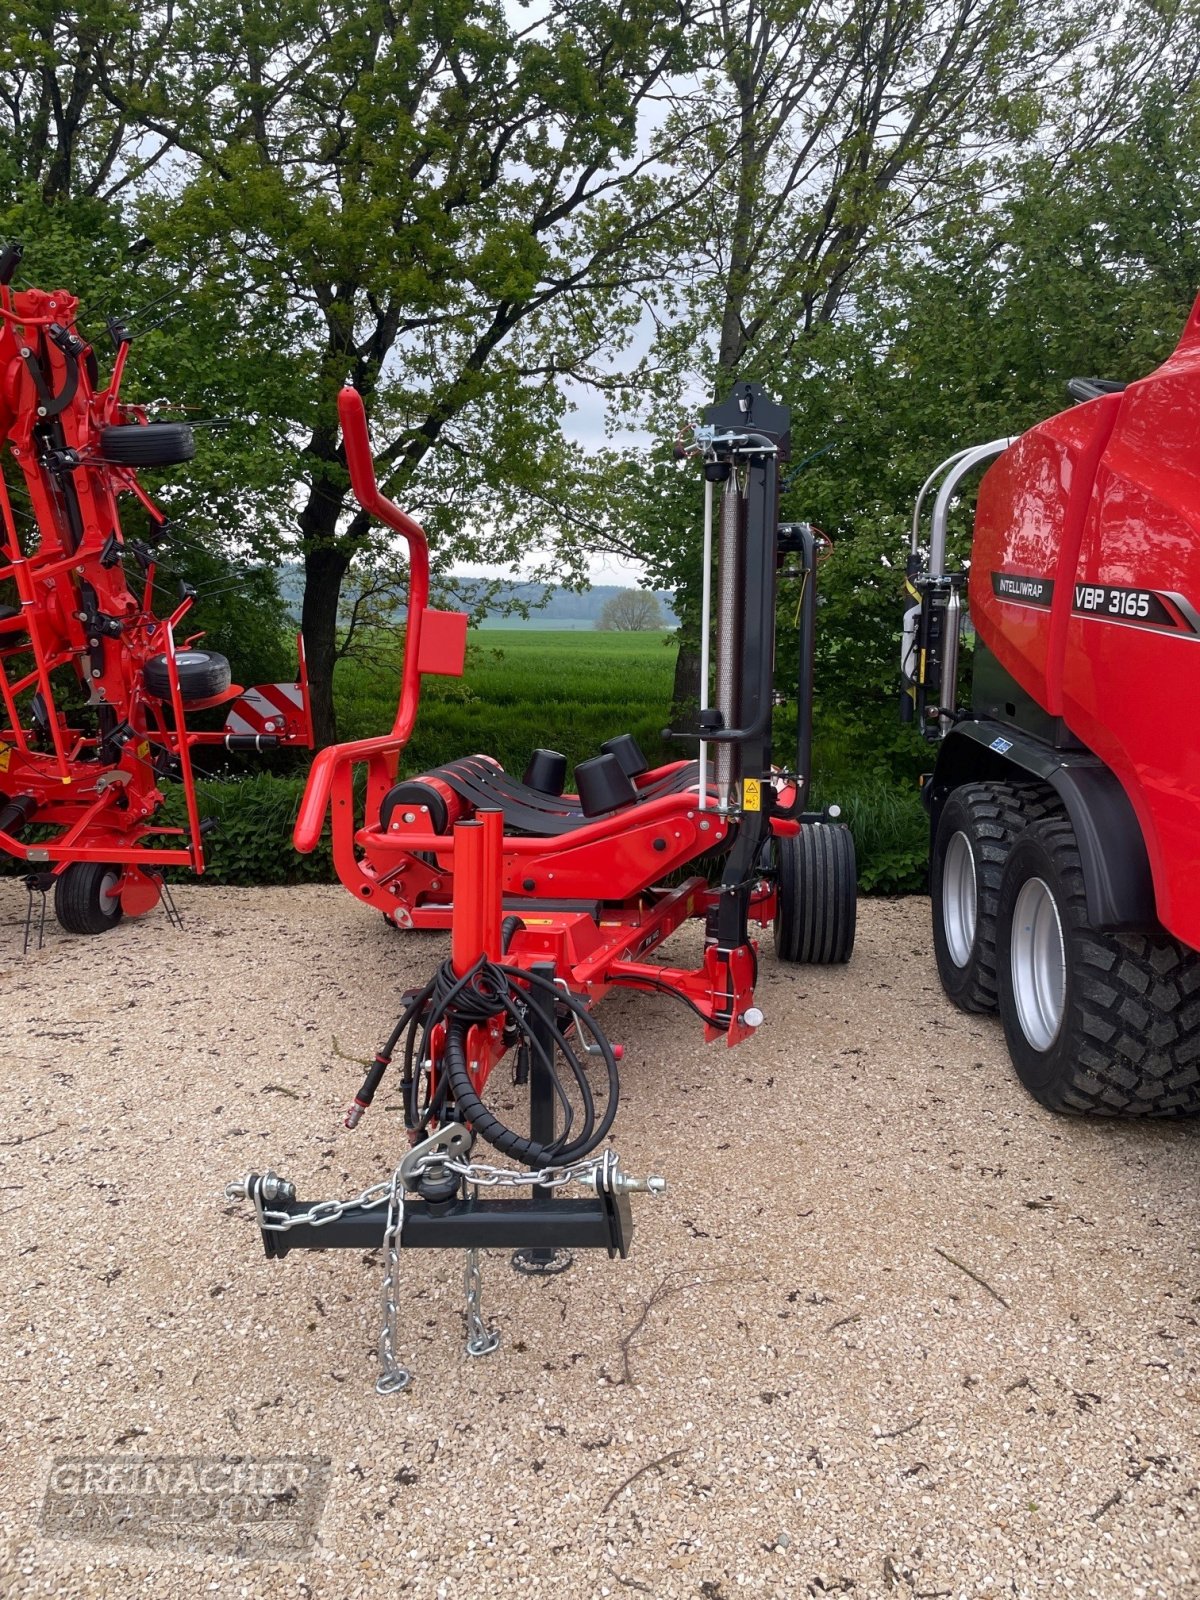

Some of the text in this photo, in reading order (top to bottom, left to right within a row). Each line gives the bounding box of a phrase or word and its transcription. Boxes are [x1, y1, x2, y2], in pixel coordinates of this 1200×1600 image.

[999, 579, 1043, 598] INTELLIWRAP
[1075, 586, 1150, 617] VBP 3165
